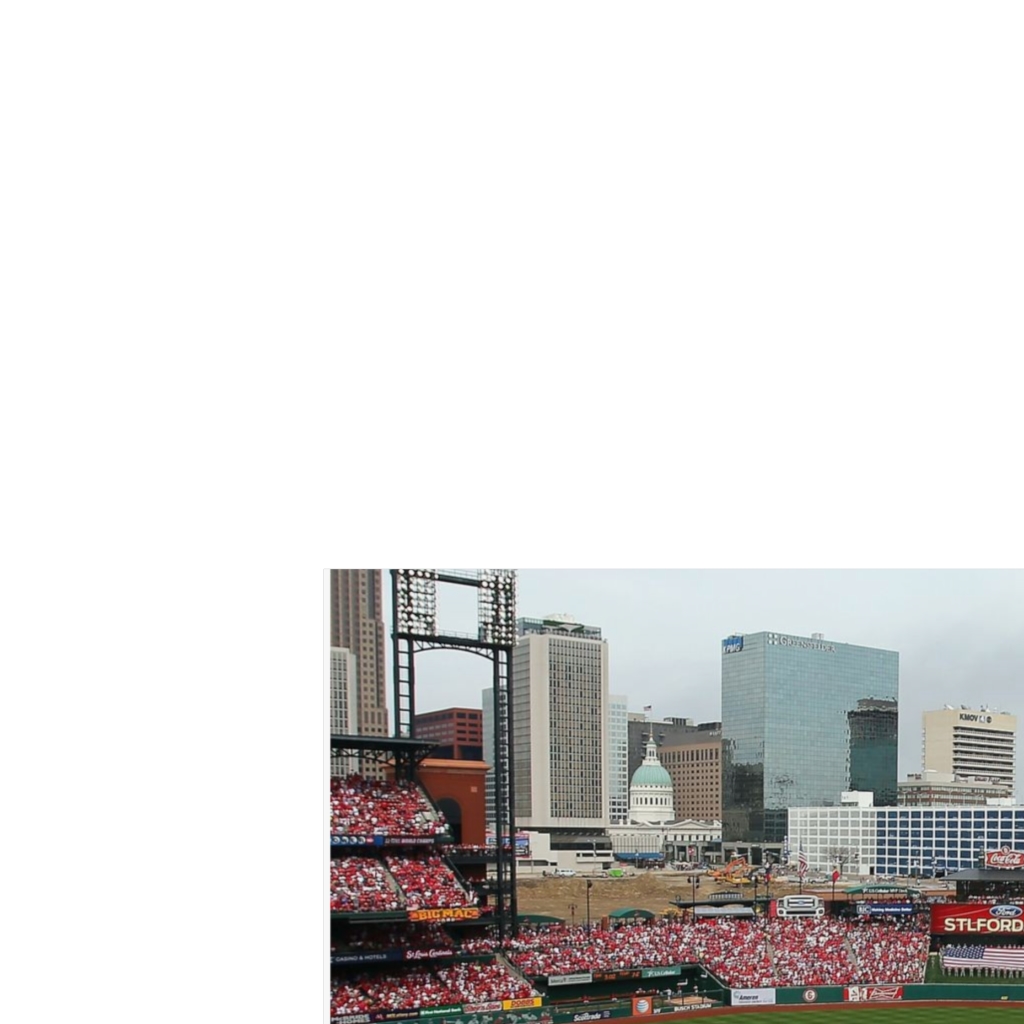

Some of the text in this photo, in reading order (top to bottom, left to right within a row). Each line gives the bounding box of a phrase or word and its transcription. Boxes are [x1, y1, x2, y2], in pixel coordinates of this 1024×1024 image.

[960, 713, 979, 722] KMOV
[419, 908, 472, 920] BIG MAC
[995, 908, 1017, 916] Ford
[429, 948, 453, 958] Cardinals
[674, 1004, 690, 1012] BUSCH
[573, 1012, 601, 1022] Scottrade
